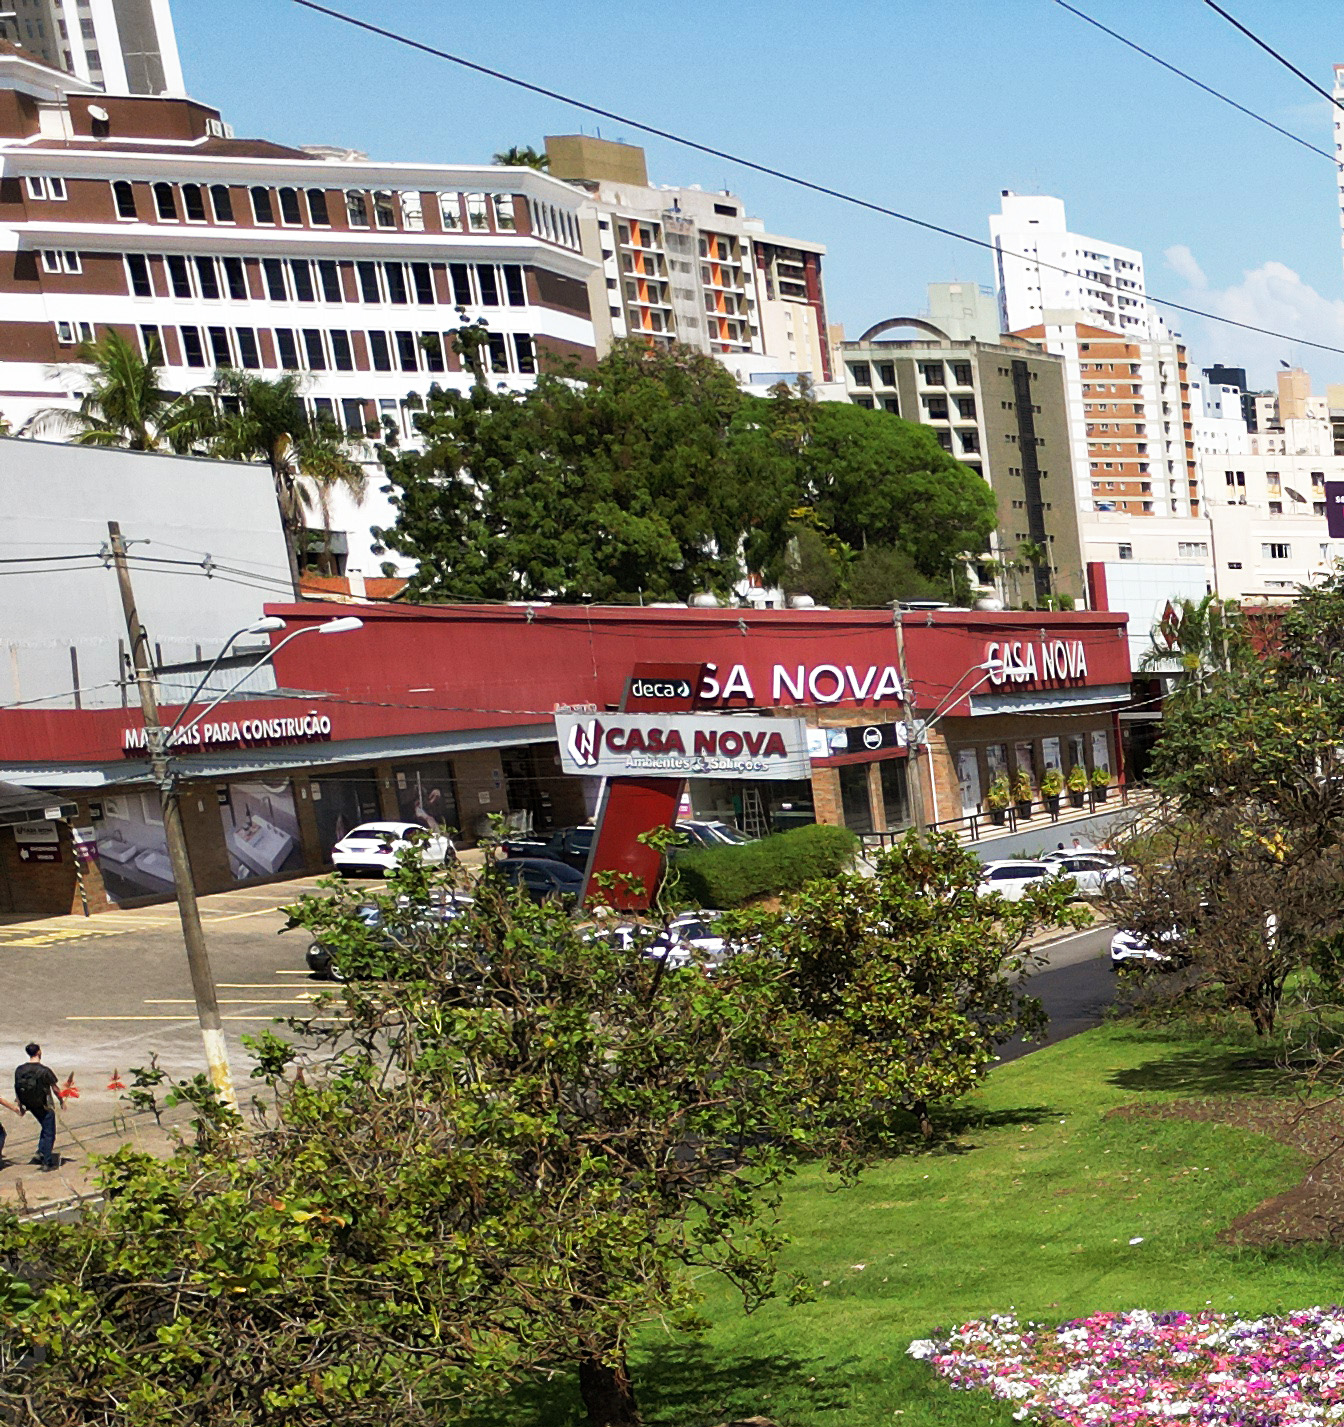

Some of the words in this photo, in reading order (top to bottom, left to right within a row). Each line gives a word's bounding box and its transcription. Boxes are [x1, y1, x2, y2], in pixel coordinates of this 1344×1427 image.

[988, 641, 1039, 686] CASA
[1041, 640, 1088, 680] NOVA
[632, 679, 675, 697] deca
[700, 663, 754, 699] SA
[772, 664, 904, 702] NOVA
[203, 721, 241, 743] PARA
[242, 710, 331, 740] CONSTRUÇÃO
[605, 727, 686, 755] CASA
[693, 730, 788, 759] NOVA
[626, 755, 690, 770] Ambientes
